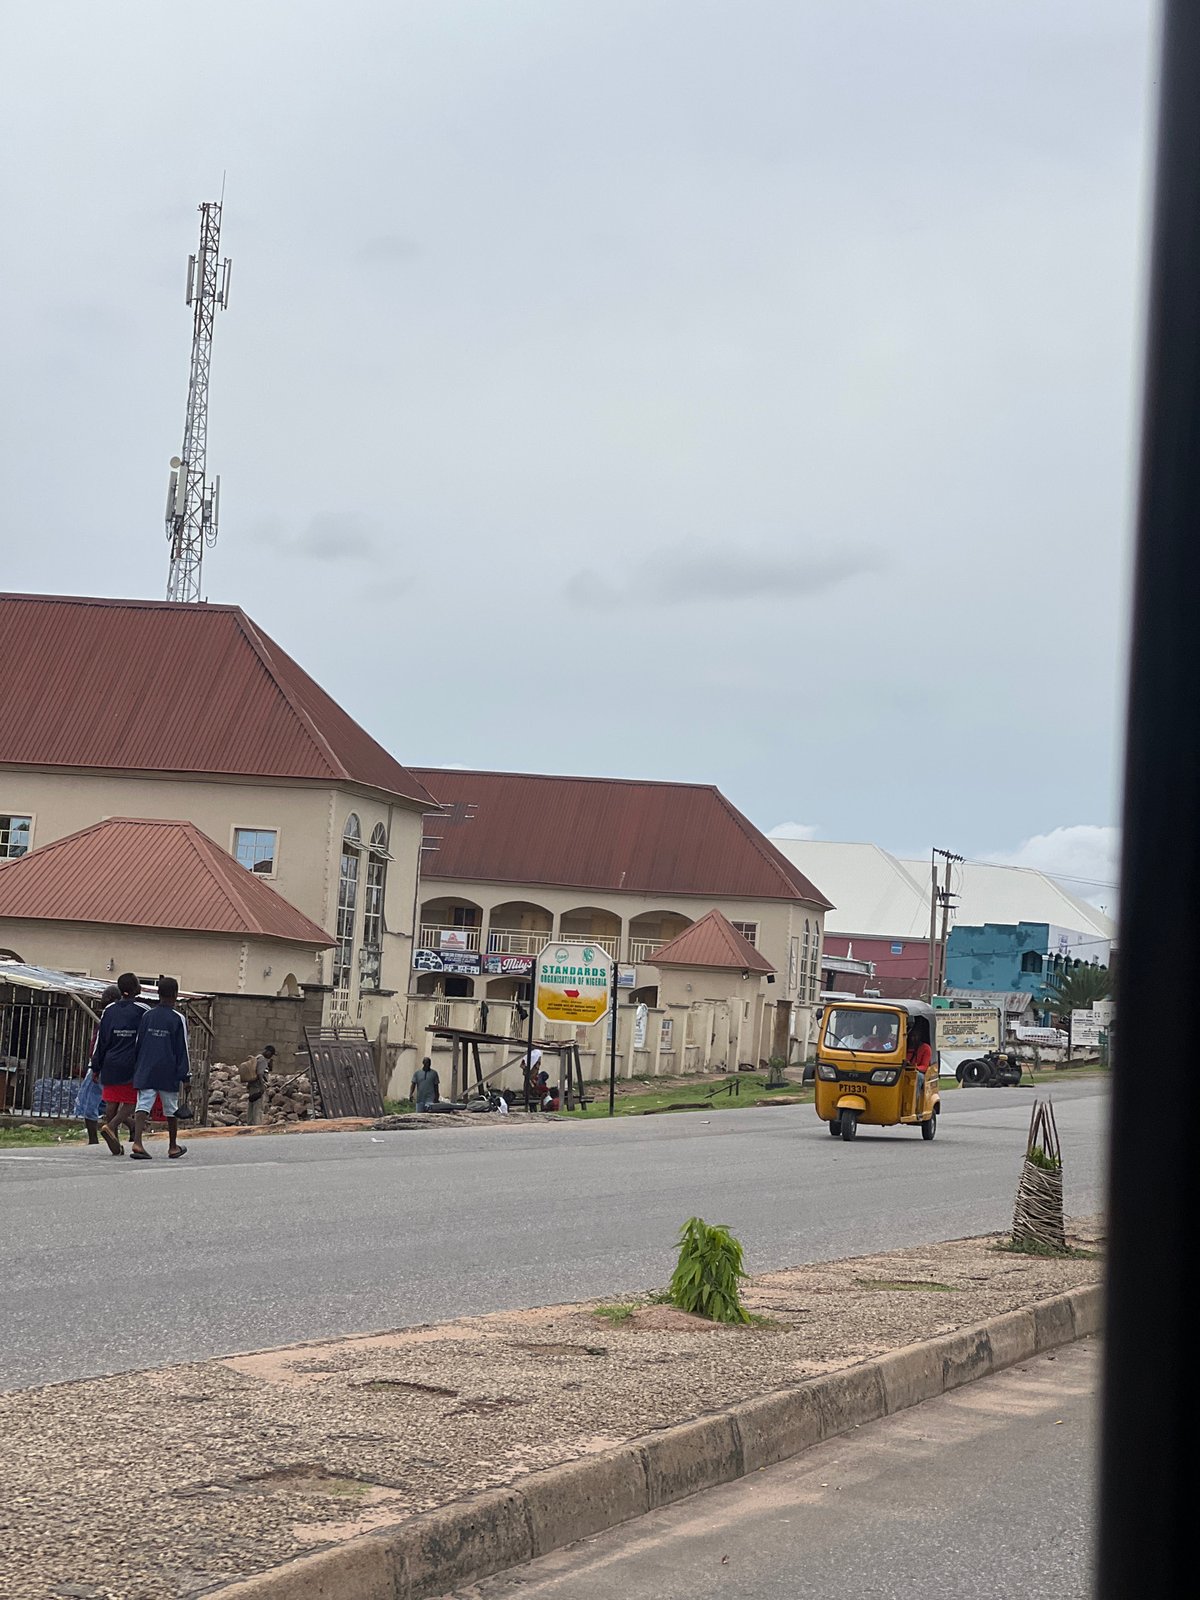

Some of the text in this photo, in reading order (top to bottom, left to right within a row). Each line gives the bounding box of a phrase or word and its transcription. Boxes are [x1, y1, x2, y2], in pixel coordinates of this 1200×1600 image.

[542, 965, 606, 977] STANDARDS
[541, 974, 576, 985] ORGANISATION
[578, 977, 584, 985] OF
[586, 977, 607, 987] NIGERIA
[839, 1083, 867, 1094] PT133R
